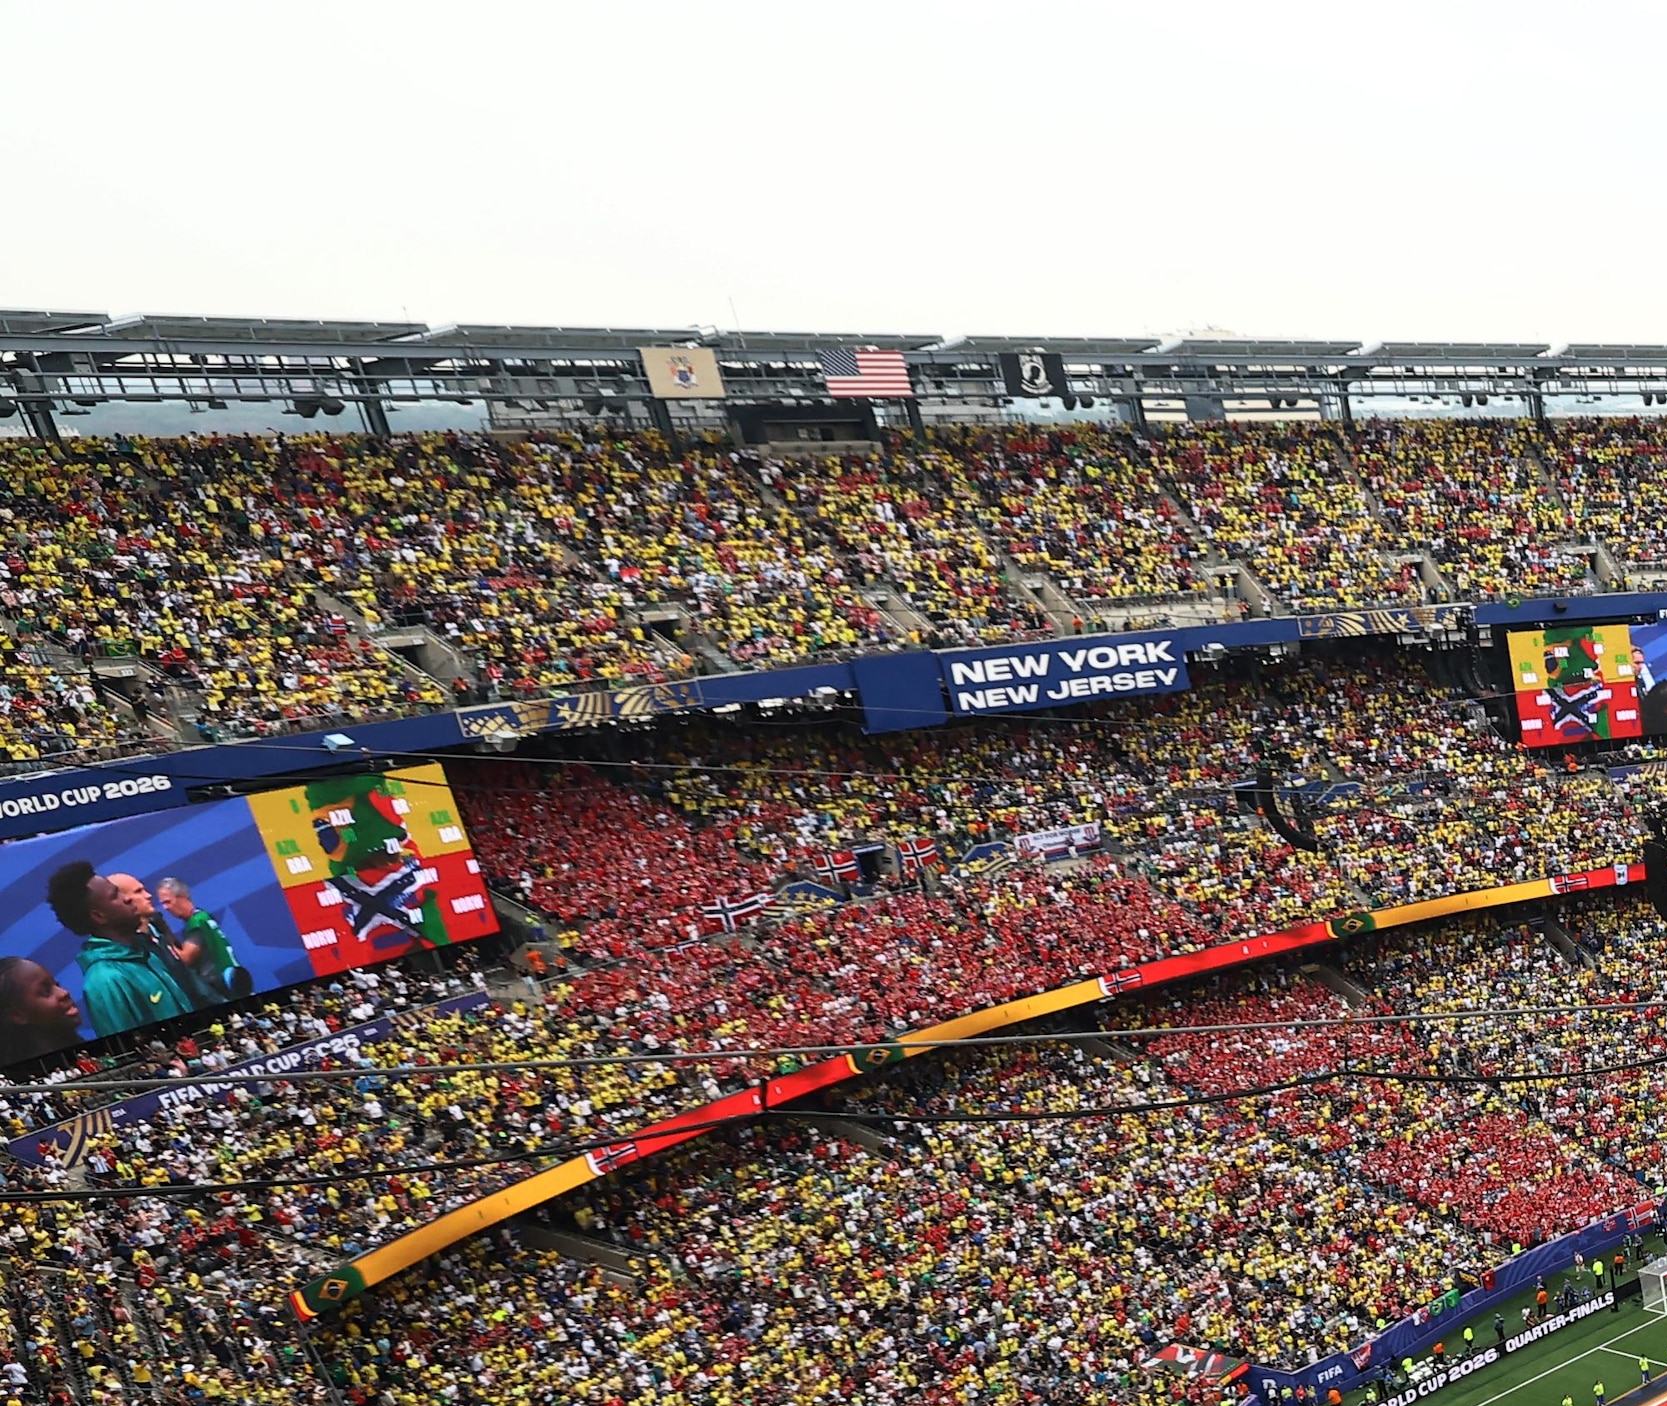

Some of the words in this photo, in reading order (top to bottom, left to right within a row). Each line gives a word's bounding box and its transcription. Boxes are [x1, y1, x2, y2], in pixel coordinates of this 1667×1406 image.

[950, 653, 1050, 685] NEW
[1058, 640, 1177, 672] YORK
[957, 684, 1039, 711] NEW
[1046, 667, 1178, 700] JERSEY
[61, 786, 101, 807] CUP
[103, 775, 172, 800] 2026
[329, 808, 356, 826] AZIL
[157, 1083, 202, 1109] FIFA
[267, 1052, 301, 1075] CUP
[1505, 1291, 1615, 1353] QUARTER-FINALS
[1317, 1364, 1343, 1384] FIFA
[1418, 1373, 1448, 1397] CUP
[1448, 1348, 1498, 1382] 2026
